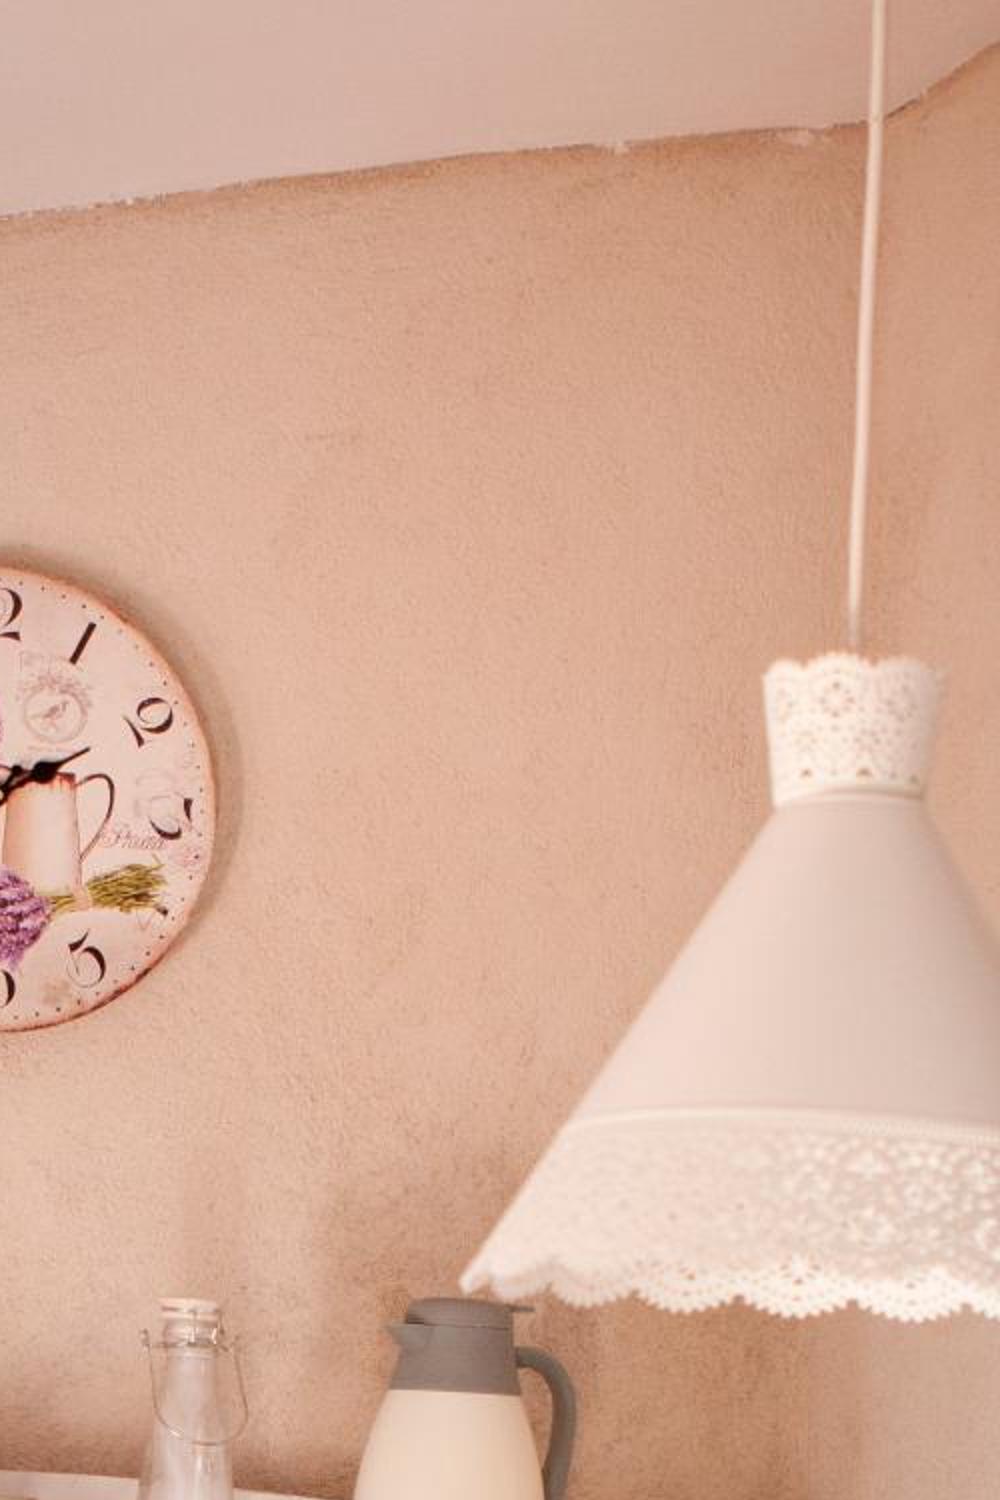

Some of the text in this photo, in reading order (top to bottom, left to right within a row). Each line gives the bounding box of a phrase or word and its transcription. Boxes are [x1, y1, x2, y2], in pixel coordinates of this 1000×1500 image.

[68, 621, 97, 665] 1
[123, 696, 174, 748] 2
[66, 928, 107, 988] 5
